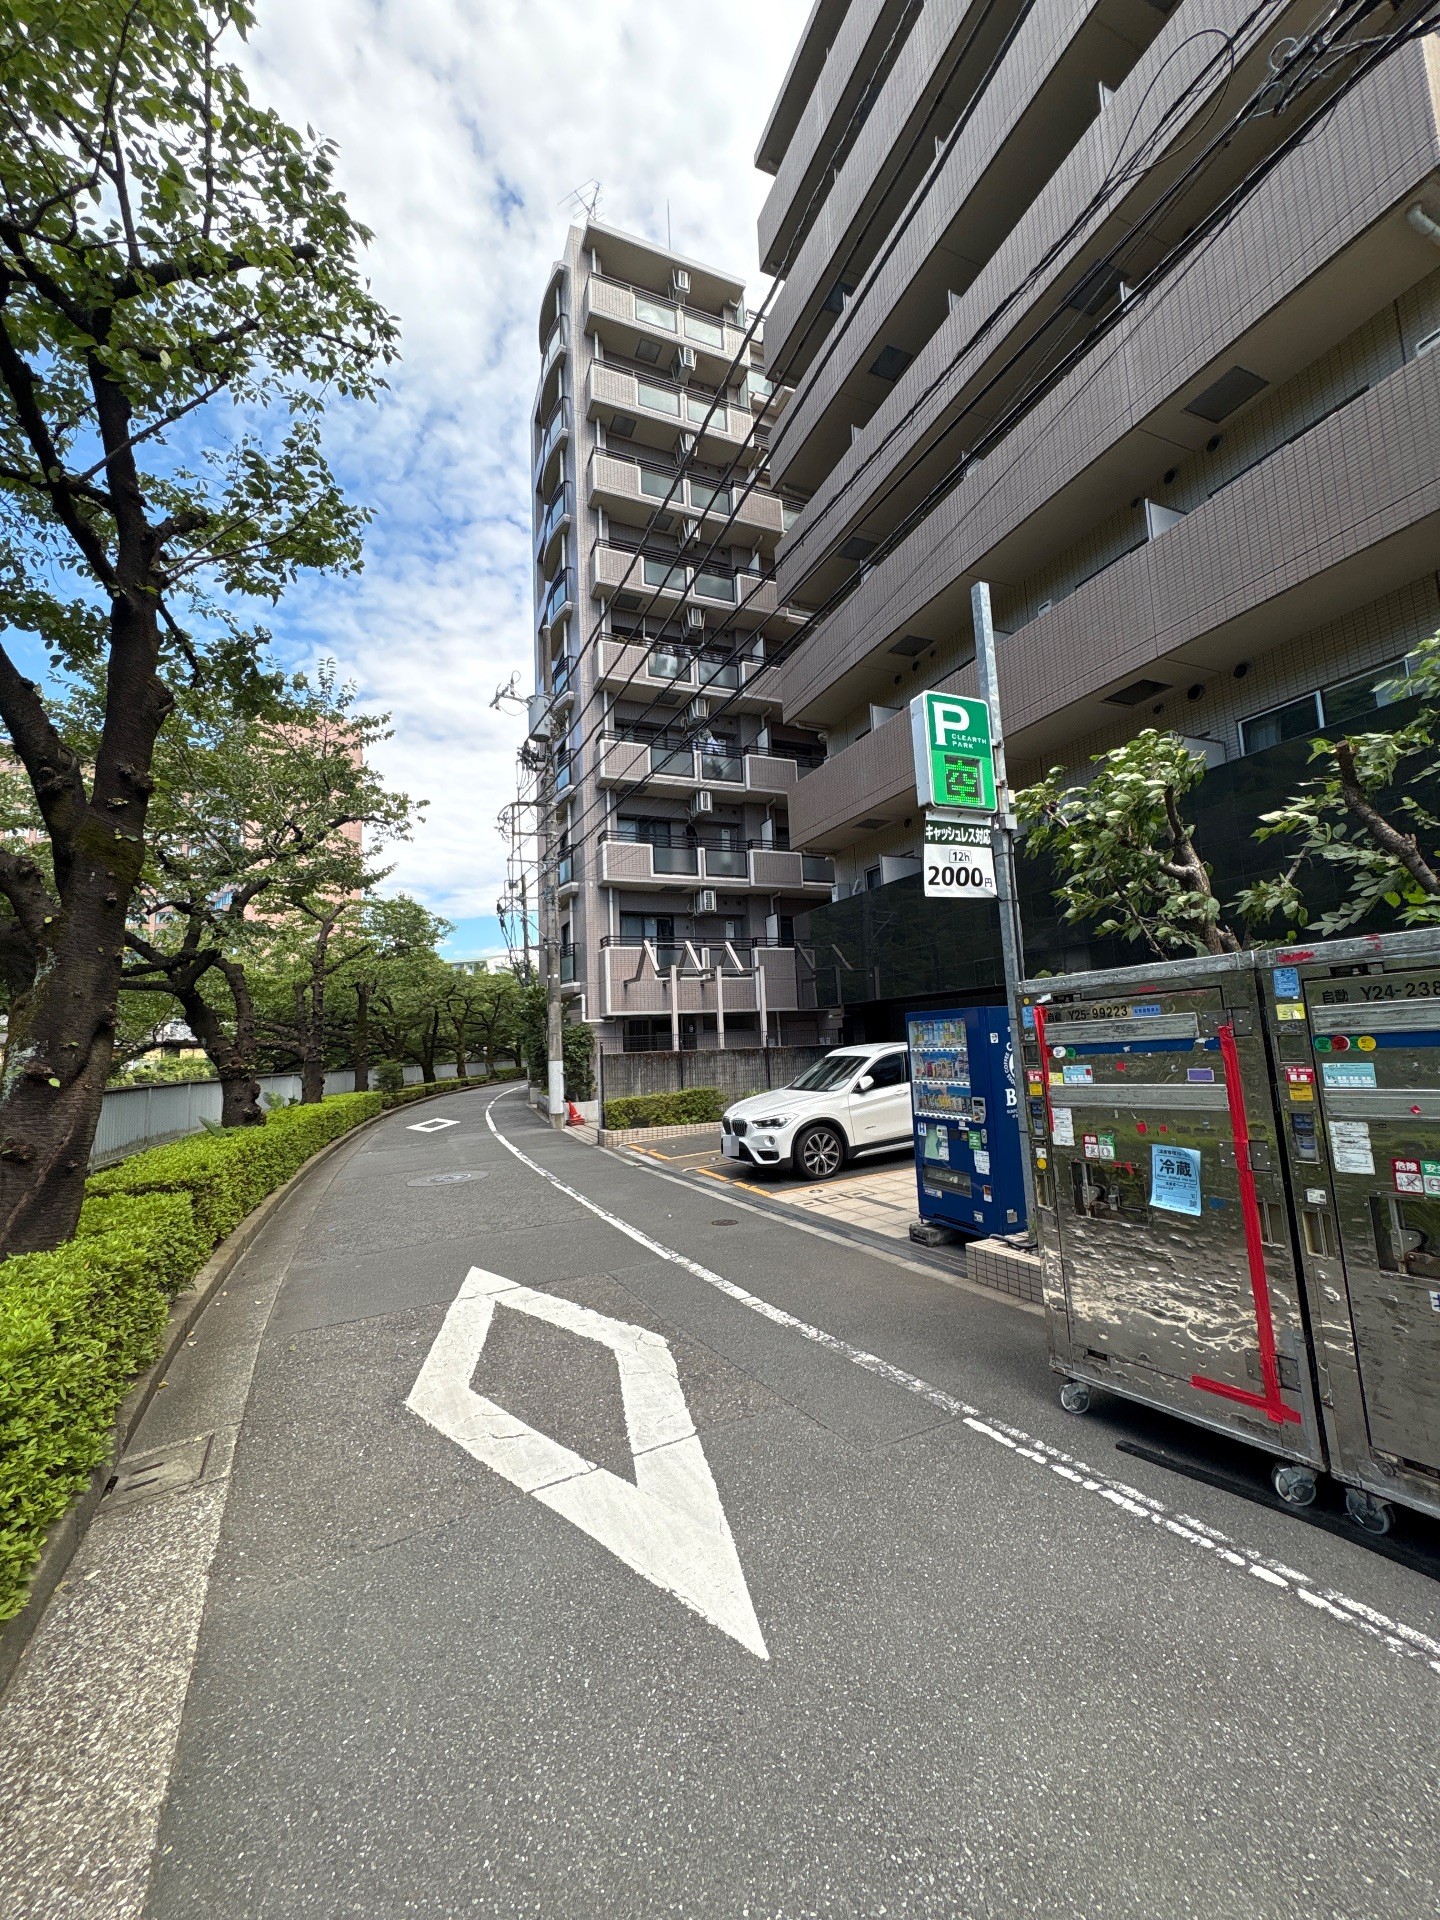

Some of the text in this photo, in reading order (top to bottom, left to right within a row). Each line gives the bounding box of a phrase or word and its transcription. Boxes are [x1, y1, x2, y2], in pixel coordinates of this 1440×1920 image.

[931, 702, 970, 745] P
[951, 733, 987, 745] CLEARTH
[952, 740, 974, 749] PARK
[945, 760, 980, 804] 空
[925, 823, 991, 845] キャッシュレス対応
[952, 851, 970, 862] 12h
[1068, 1005, 1128, 1021] Y25-99223
[1159, 1158, 1192, 1178] 冷蔵
